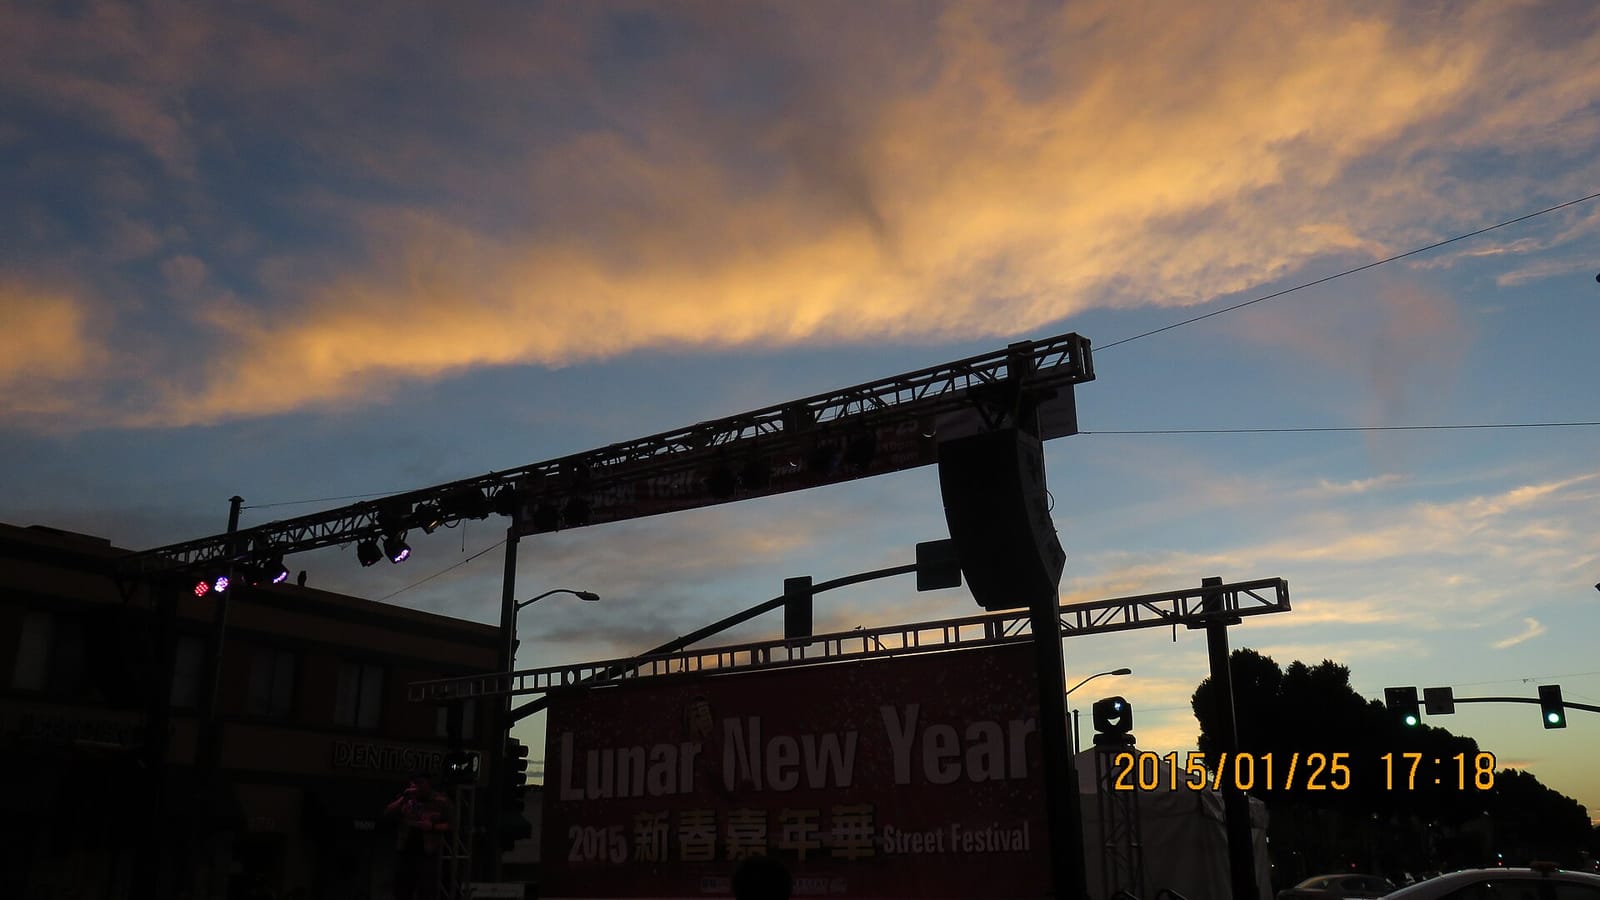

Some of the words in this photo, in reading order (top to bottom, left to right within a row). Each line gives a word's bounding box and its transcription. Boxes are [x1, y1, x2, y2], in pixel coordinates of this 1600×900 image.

[560, 731, 702, 800] Lunar
[723, 716, 858, 792] New
[880, 703, 1037, 785] Year
[568, 824, 629, 864] 2015
[632, 803, 876, 864] 新春嘉年華
[883, 824, 945, 854] Street
[951, 819, 1031, 853] Festival
